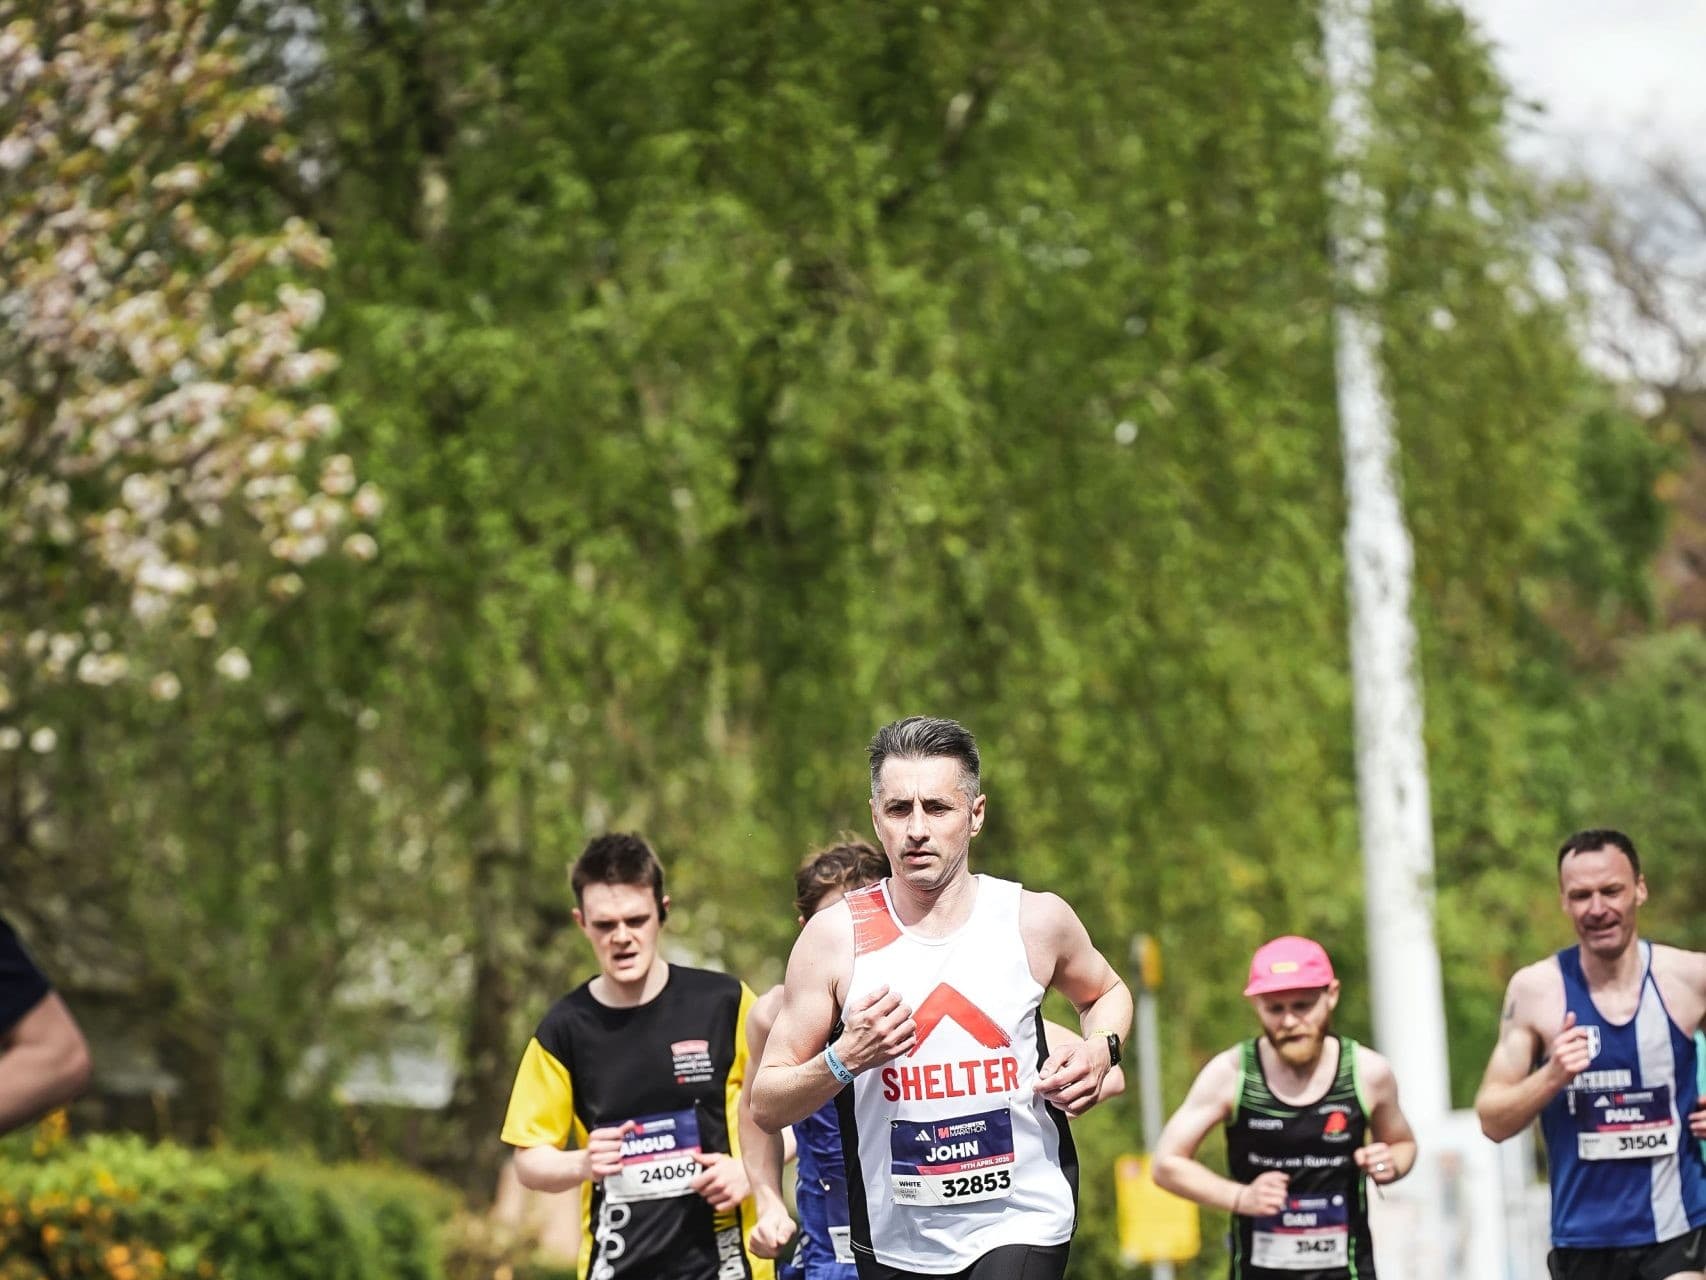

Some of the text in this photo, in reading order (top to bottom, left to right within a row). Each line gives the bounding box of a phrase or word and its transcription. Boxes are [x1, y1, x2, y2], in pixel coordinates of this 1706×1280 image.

[881, 1056, 1020, 1103] SHELTER
[1605, 1107, 1645, 1123] PAUL
[620, 1134, 676, 1157] ANGUS
[926, 1140, 979, 1162] JOHN
[1618, 1133, 1668, 1151] 31504
[640, 1162, 696, 1184] 24069
[976, 1159, 994, 1168] APRIL
[942, 1170, 1011, 1198] 32853
